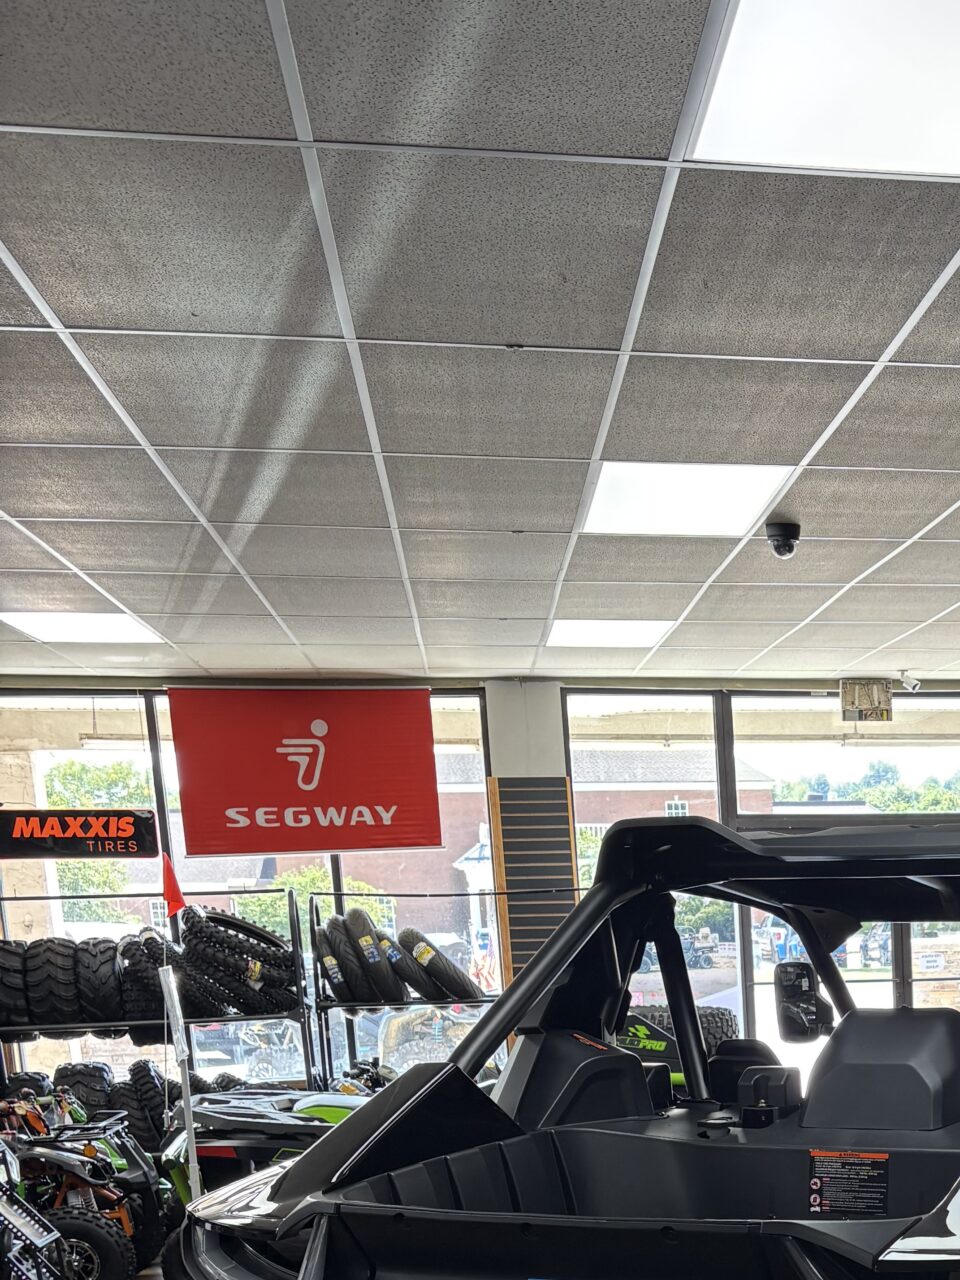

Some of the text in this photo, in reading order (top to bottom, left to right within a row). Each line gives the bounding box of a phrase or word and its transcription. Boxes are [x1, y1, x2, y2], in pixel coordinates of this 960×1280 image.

[12, 816, 135, 838] MAXXIS
[225, 805, 398, 828] SEGWAY
[86, 840, 138, 852] TIRES
